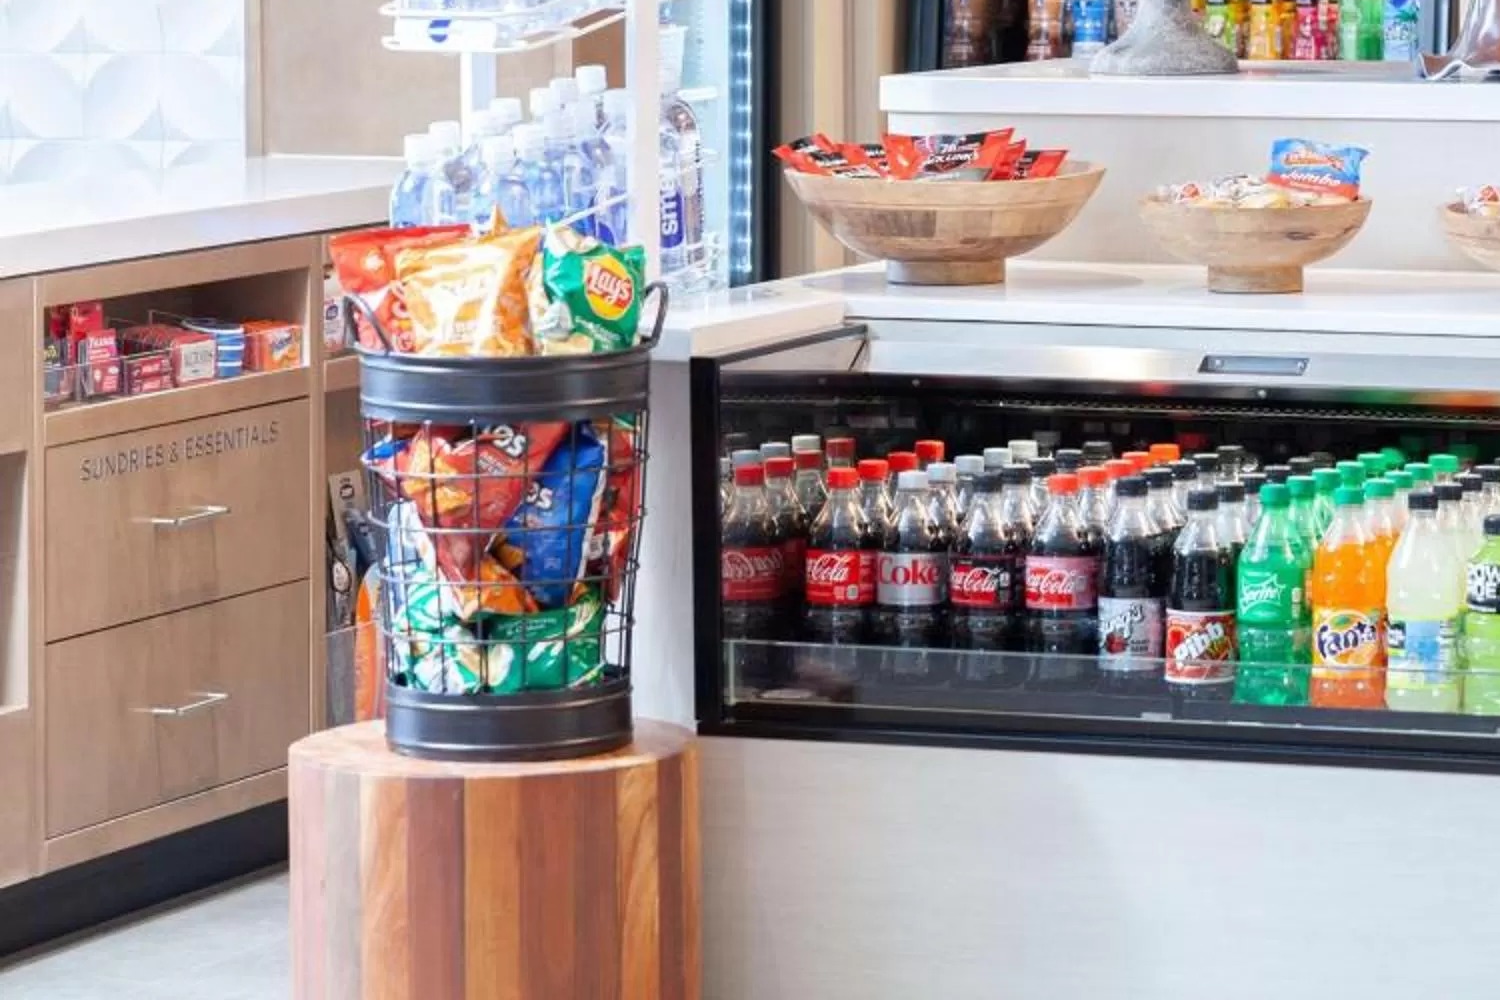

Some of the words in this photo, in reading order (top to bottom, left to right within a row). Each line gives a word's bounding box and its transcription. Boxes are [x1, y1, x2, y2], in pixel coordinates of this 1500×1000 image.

[80, 443, 165, 481] SUNDRIES
[169, 441, 179, 464] &
[184, 420, 280, 461] ESSENTIALS
[878, 555, 940, 586] Coke
